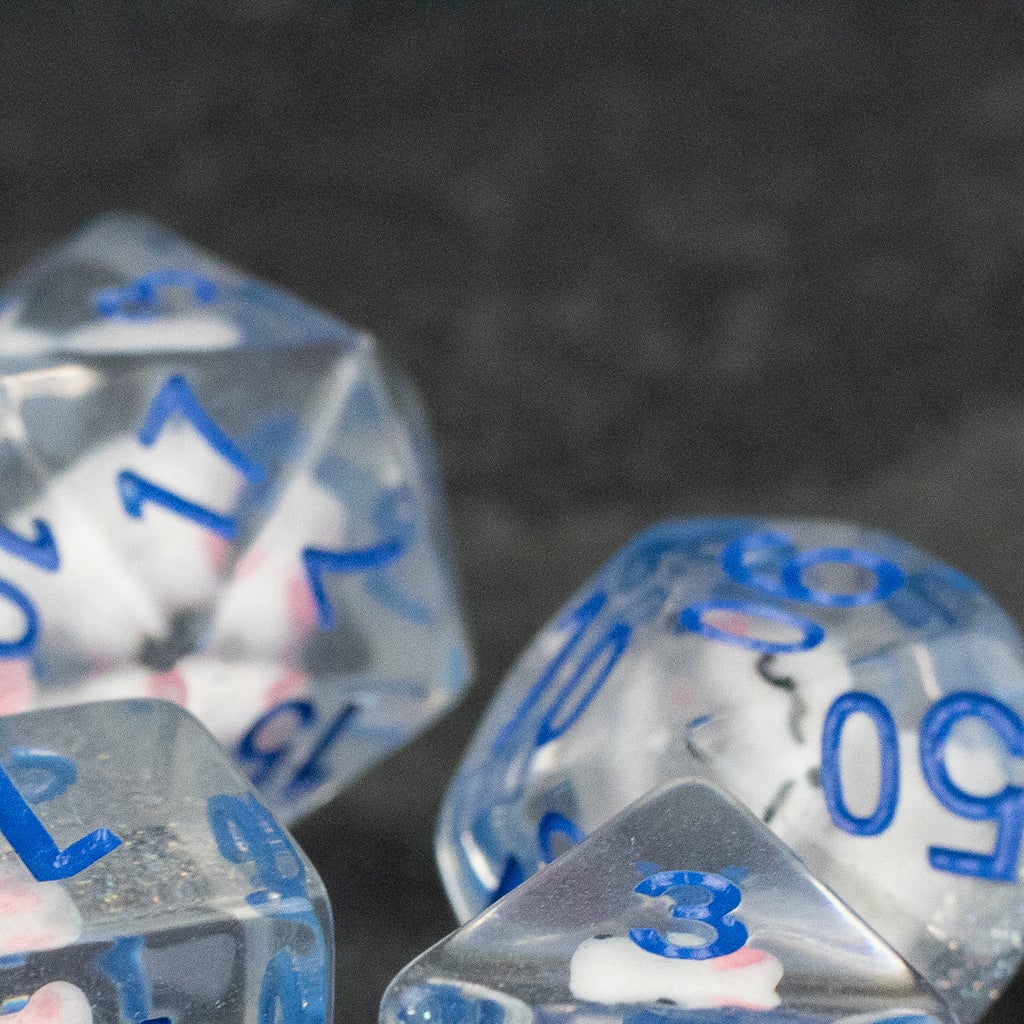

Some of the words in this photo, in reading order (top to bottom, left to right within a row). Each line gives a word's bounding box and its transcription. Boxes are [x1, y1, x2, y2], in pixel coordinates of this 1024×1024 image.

[117, 374, 266, 540] 17
[820, 690, 1024, 882] 50
[629, 869, 748, 959] 3
